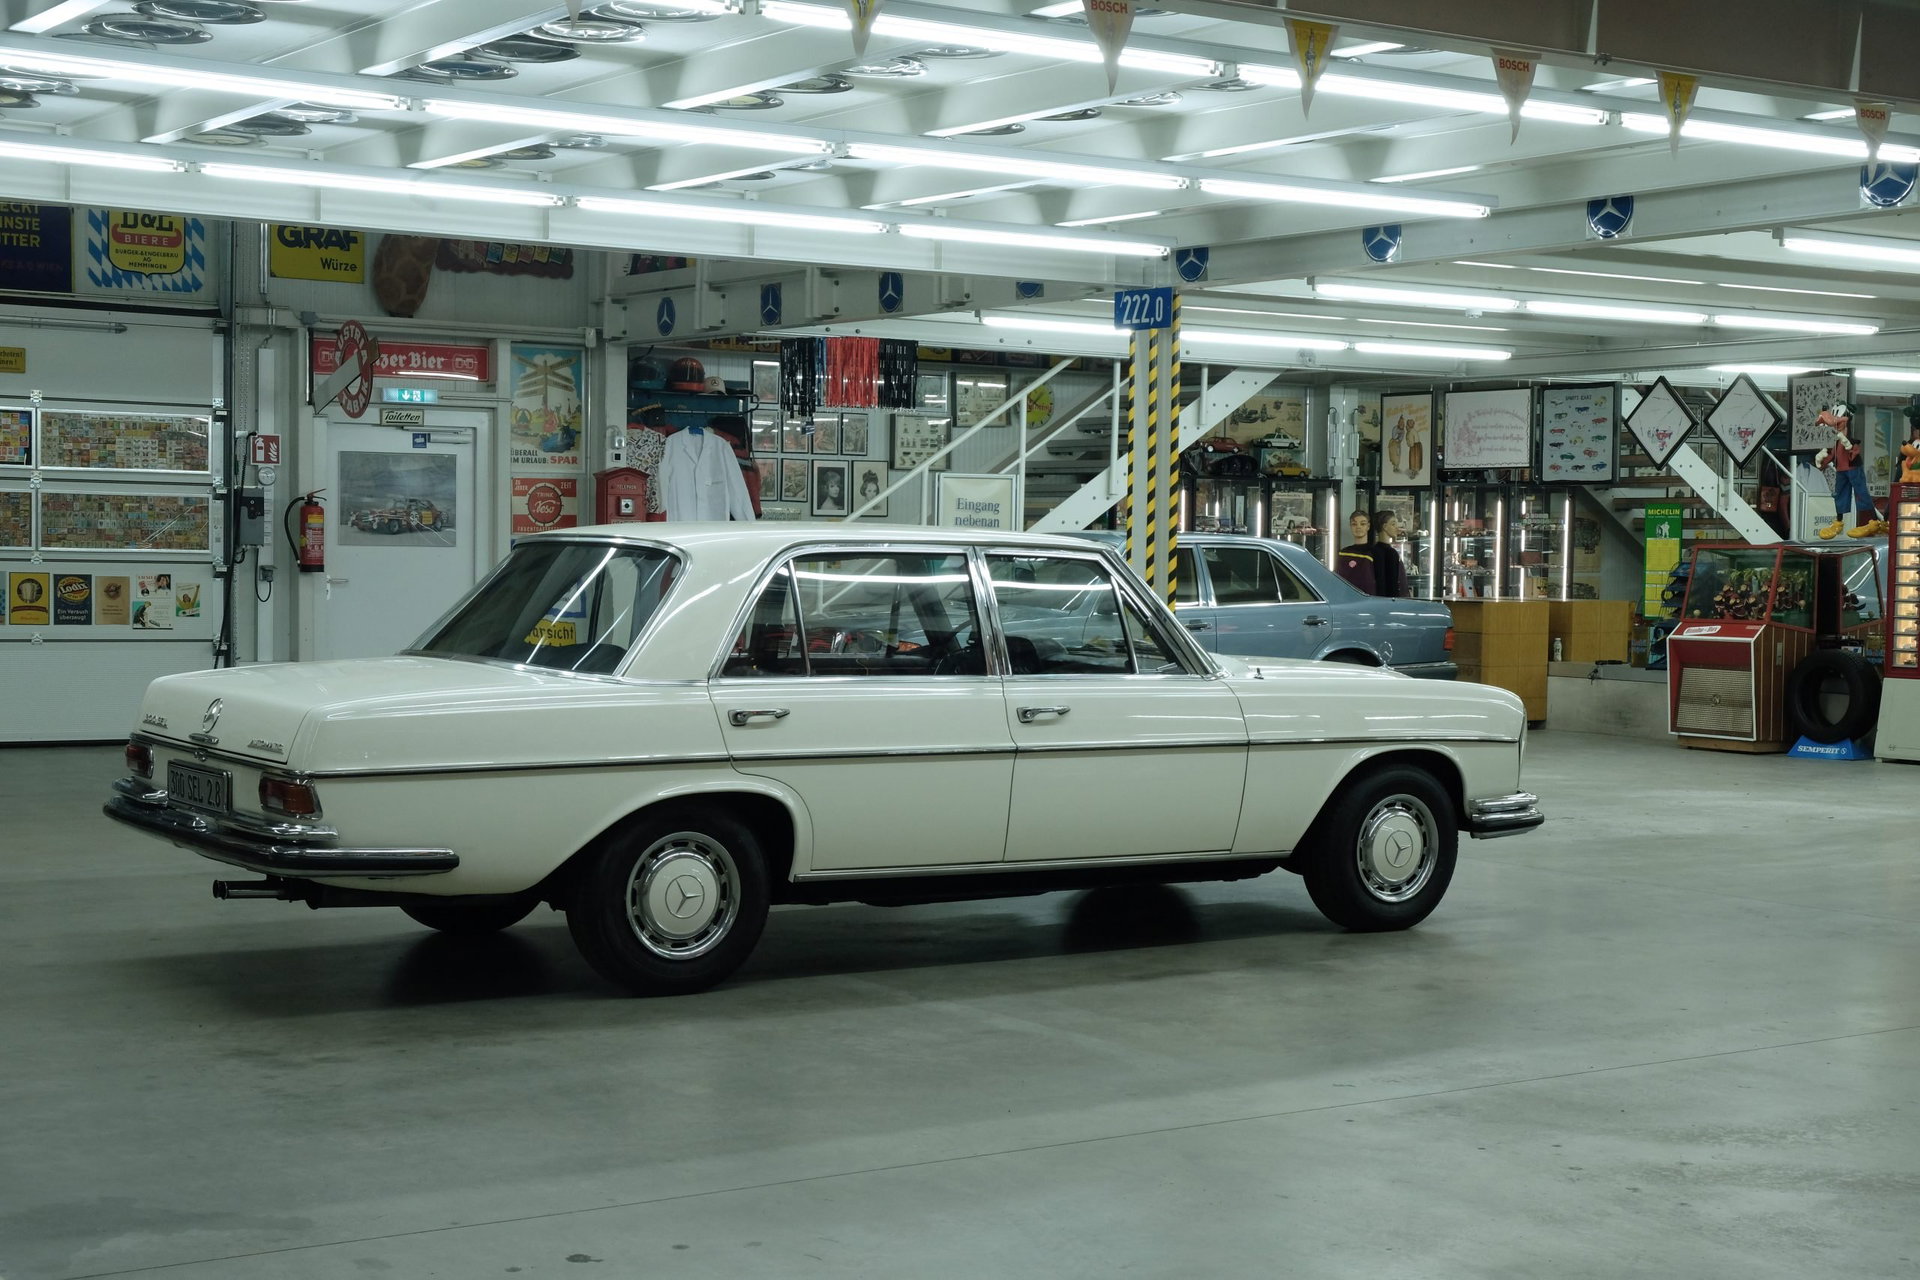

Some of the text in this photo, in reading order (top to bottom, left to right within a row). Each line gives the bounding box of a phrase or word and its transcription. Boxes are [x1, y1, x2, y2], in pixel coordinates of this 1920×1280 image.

[1091, 0, 1128, 14] BOSCH
[1498, 58, 1530, 73] BOSCH
[1860, 108, 1886, 121] BOSCH
[0, 232, 41, 248] TTER
[125, 234, 169, 246] BIERE
[277, 225, 359, 252] GRAF
[128, 261, 168, 270] MEMMINGEN
[320, 257, 358, 272] Würze
[1122, 293, 1163, 325] 222,0
[408, 351, 444, 369] Bier
[341, 378, 369, 413] TABAK
[384, 410, 421, 422] Toiletten
[550, 455, 578, 465] SPAR
[560, 481, 572, 489] ZEIT
[957, 497, 1000, 515] Eingang
[1647, 508, 1680, 516] MICHELIN
[955, 514, 1000, 528] nebenan
[59, 581, 89, 595] Lodix
[532, 626, 574, 639] orsicht
[1797, 745, 1840, 754] SEMPERIT
[170, 770, 221, 808] 300 SEL 2.8
